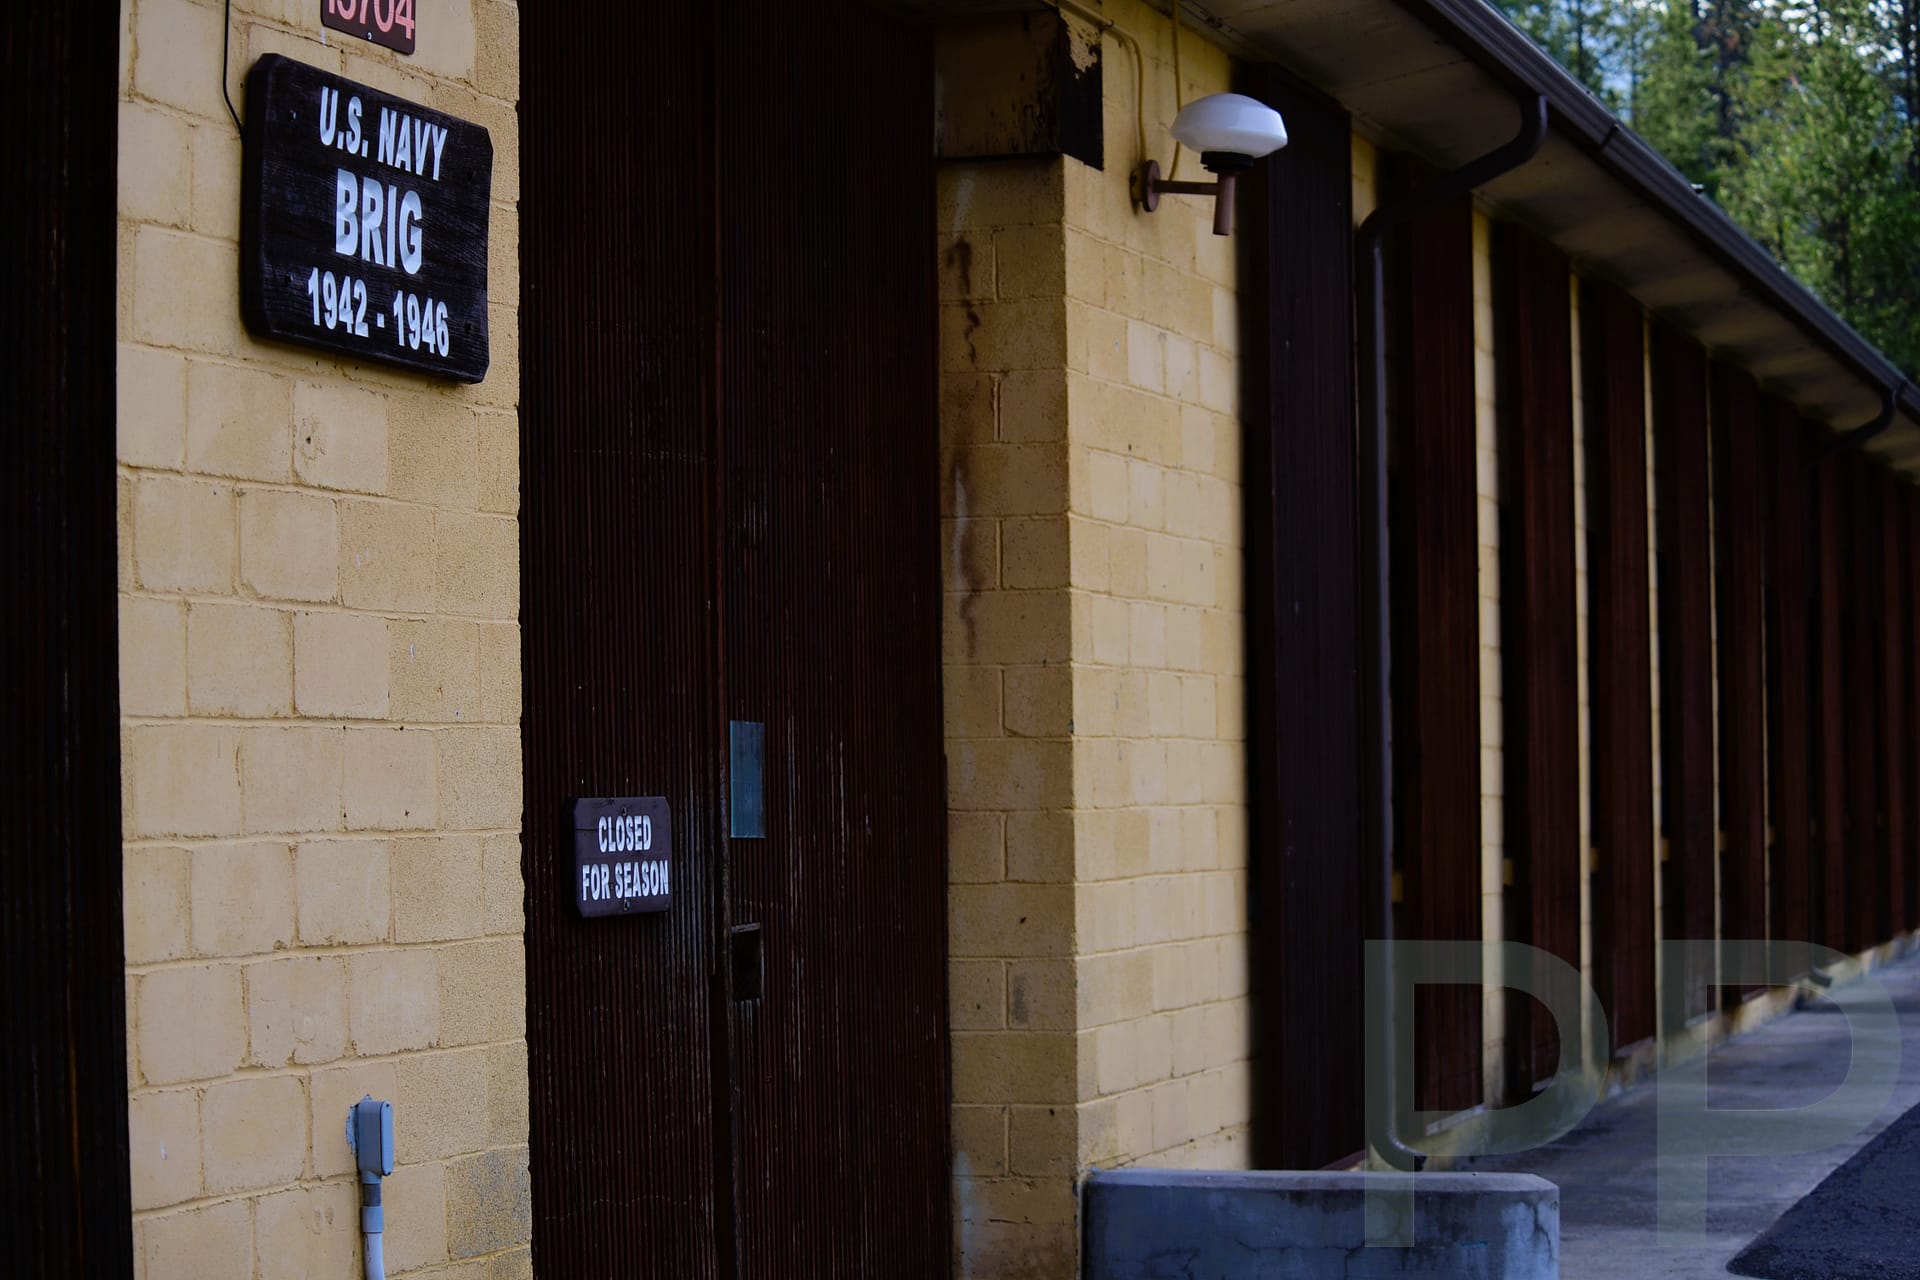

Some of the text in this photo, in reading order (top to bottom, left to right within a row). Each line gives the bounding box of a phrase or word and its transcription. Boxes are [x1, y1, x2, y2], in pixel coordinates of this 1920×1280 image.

[319, 86, 448, 181] U.S. NAVY
[335, 168, 423, 275] BRIG
[307, 267, 369, 338] 1942
[393, 290, 450, 357] 1946
[598, 814, 652, 853] CLOSED
[582, 859, 669, 901] FOR SEASON
